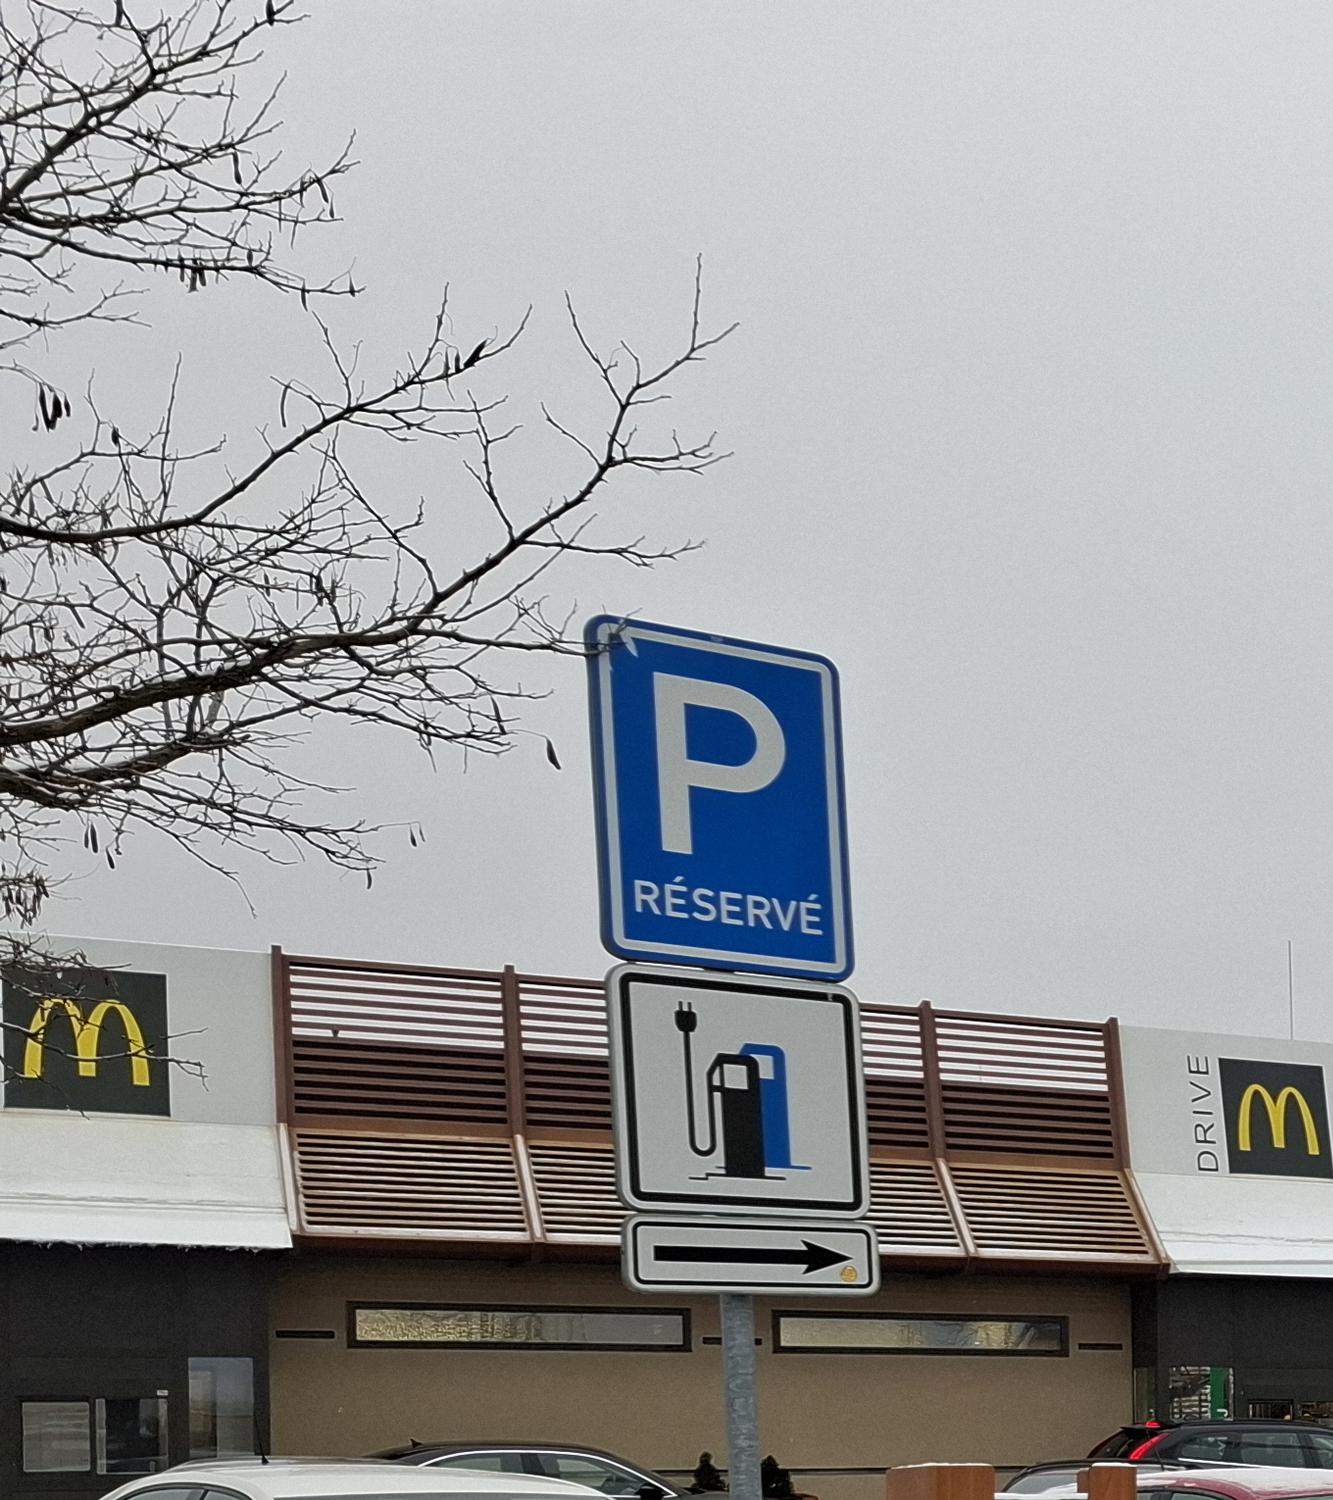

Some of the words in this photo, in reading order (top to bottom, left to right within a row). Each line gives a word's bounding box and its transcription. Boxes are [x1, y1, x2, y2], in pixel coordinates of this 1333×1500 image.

[653, 671, 786, 855] P
[633, 876, 824, 936] RÉSERVÉ
[1186, 1054, 1220, 1173] DRIVE
